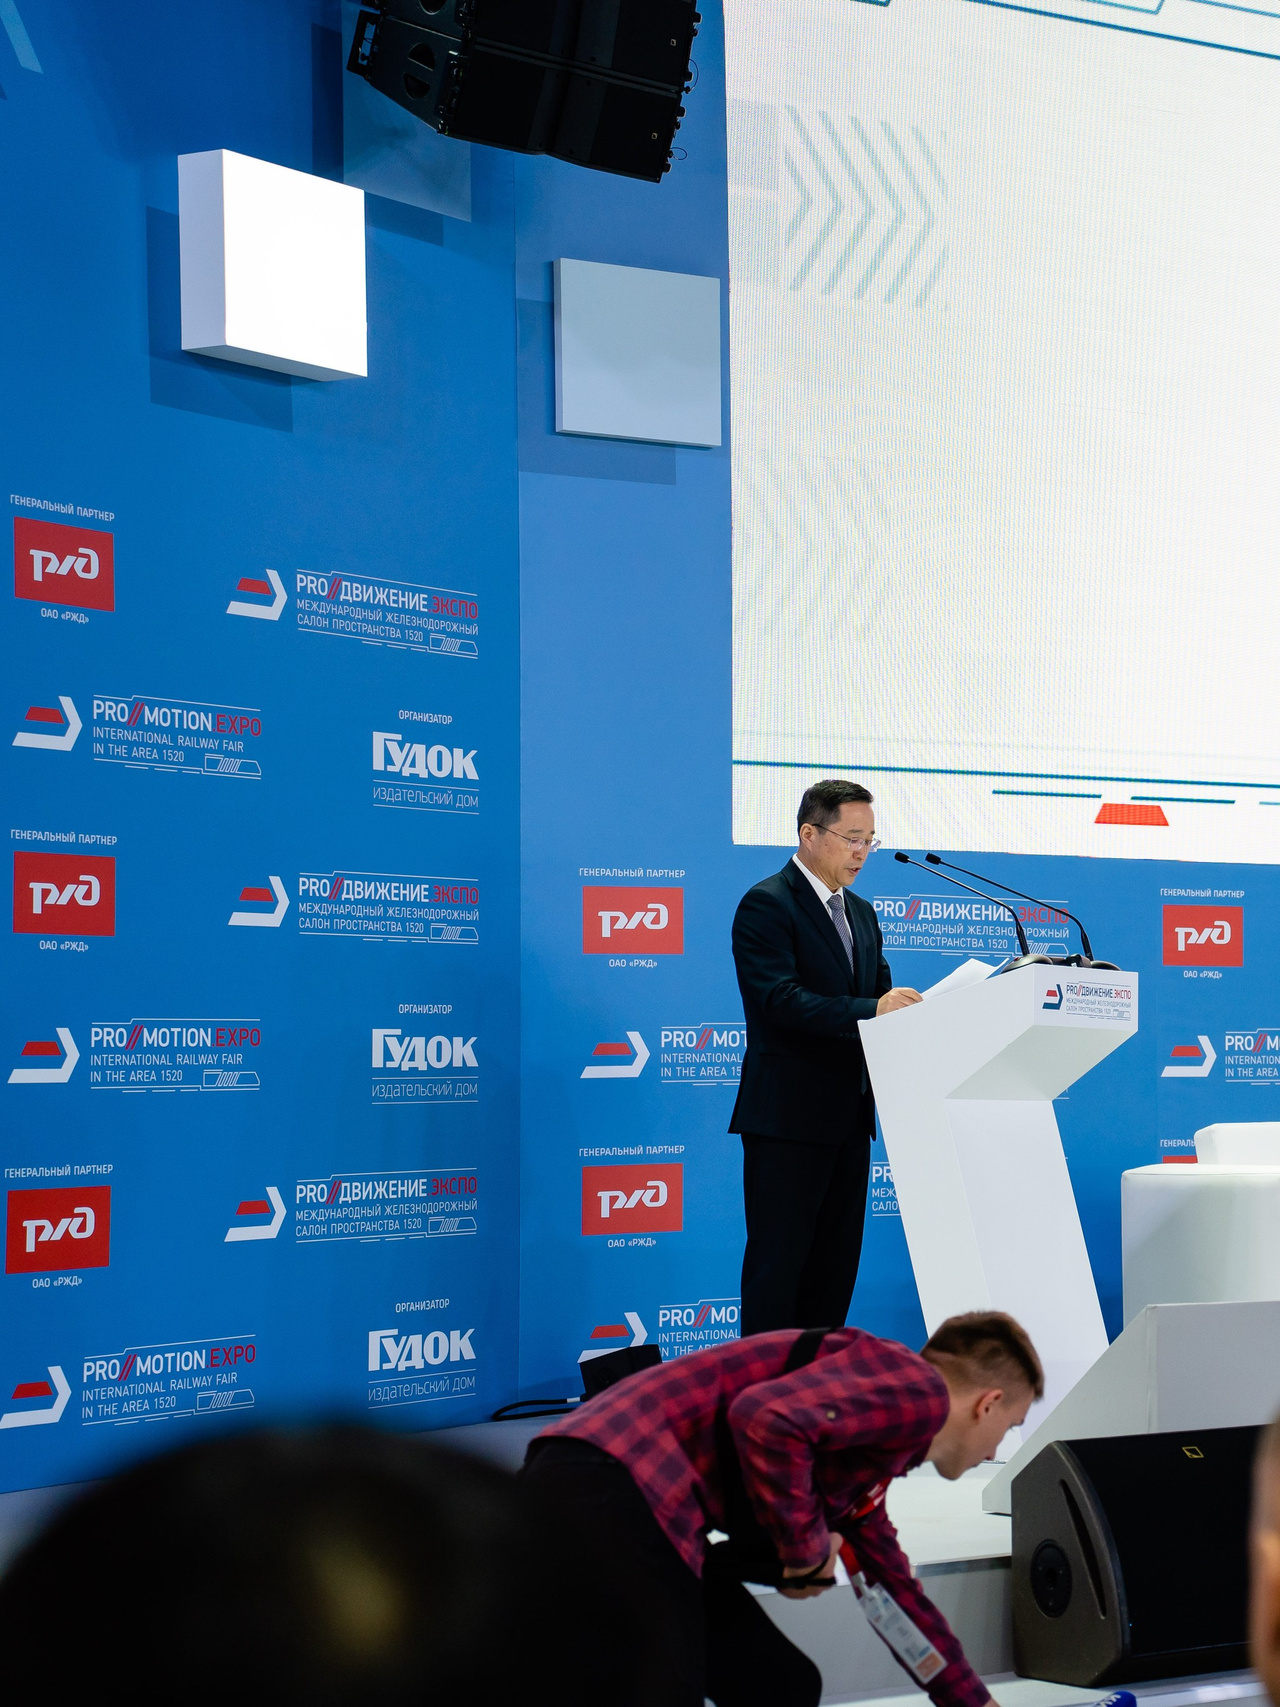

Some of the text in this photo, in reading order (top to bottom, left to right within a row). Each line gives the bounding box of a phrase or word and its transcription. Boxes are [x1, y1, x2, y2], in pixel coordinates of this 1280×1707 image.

[10, 494, 114, 521] ГЕНЕРАЛЬНЫЙ ПАРТНЕР
[40, 608, 89, 624] ОАО «РЖД»
[296, 598, 478, 635] МЕЖДУНАРОДНЫЙ ЖЕЛЕЗНОДОРОЖНЫЙ
[297, 614, 423, 641] САЛОН ПРОСТРАНСТВА 1520
[398, 710, 452, 724] ОРГАНИЗАТОР
[93, 726, 243, 752] INTERNATIONAL RAILWAY FAIR
[93, 743, 184, 762] IN THE AREA 1520
[373, 786, 478, 808] издательский дом
[10, 829, 117, 845] ГЕНЕРАЛЬНЫЙ ПАРТНЕР
[579, 867, 685, 877] ГЕНЕРАЛЬНЫЙ ПАРТНЕР
[1160, 888, 1244, 898] ГЕНЕРАЛЬНЫЙ ПАРТНЕР
[298, 903, 478, 920] МЕЖДУНАРОДНЫЙ ЖЕЛЕЗНОДОРОЖНЫЙ
[298, 917, 423, 933] САЛОН ПРОСТРАНСТВА 1520
[879, 921, 963, 935] ЕЖДУНАРОДНЫЙ
[39, 940, 88, 952] ОАО «РЖД»
[910, 936, 1008, 949] ПРОСТРАНСТВА 1520
[608, 958, 657, 968] ОАО «РЖД»
[1183, 969, 1197, 977] ОАО
[398, 1003, 452, 1014] ОРГАНИЗАТОР
[90, 1053, 242, 1065] INTERNATIONAL RAILWAY FAIR
[661, 1053, 742, 1063] INTERNATIONAL
[90, 1070, 182, 1082] IN THE AREA 1520
[661, 1066, 727, 1077] IN THE AREA
[1225, 1067, 1234, 1076] IN
[1236, 1067, 1253, 1077] THE
[1256, 1067, 1278, 1076] AREA
[371, 1081, 477, 1098] издательский дом
[578, 1144, 684, 1156] ГЕНЕРАЛЬНЫЙ ПАРТНЕР
[4, 1164, 113, 1178] ГЕНЕРАЛЬНЫЙ ПАРТНЕР
[295, 1198, 477, 1220] МЕЖДУНАРОДНЫЙ ЖЕЛЕЗНОДОРОЖНЫЙ
[295, 1217, 421, 1236] САЛОН ПРОСТРАНСТВА 1520
[607, 1237, 656, 1247] ОАО «РЖД»
[32, 1275, 82, 1288] ОАО «РЖД»
[395, 1298, 449, 1312] ОРГАНИЗАТОР
[82, 1371, 237, 1401] INTERNATIONAL RAILWAY FAIR
[368, 1376, 475, 1401] издательский дом
[81, 1396, 176, 1418] IN THE AREA 1520
